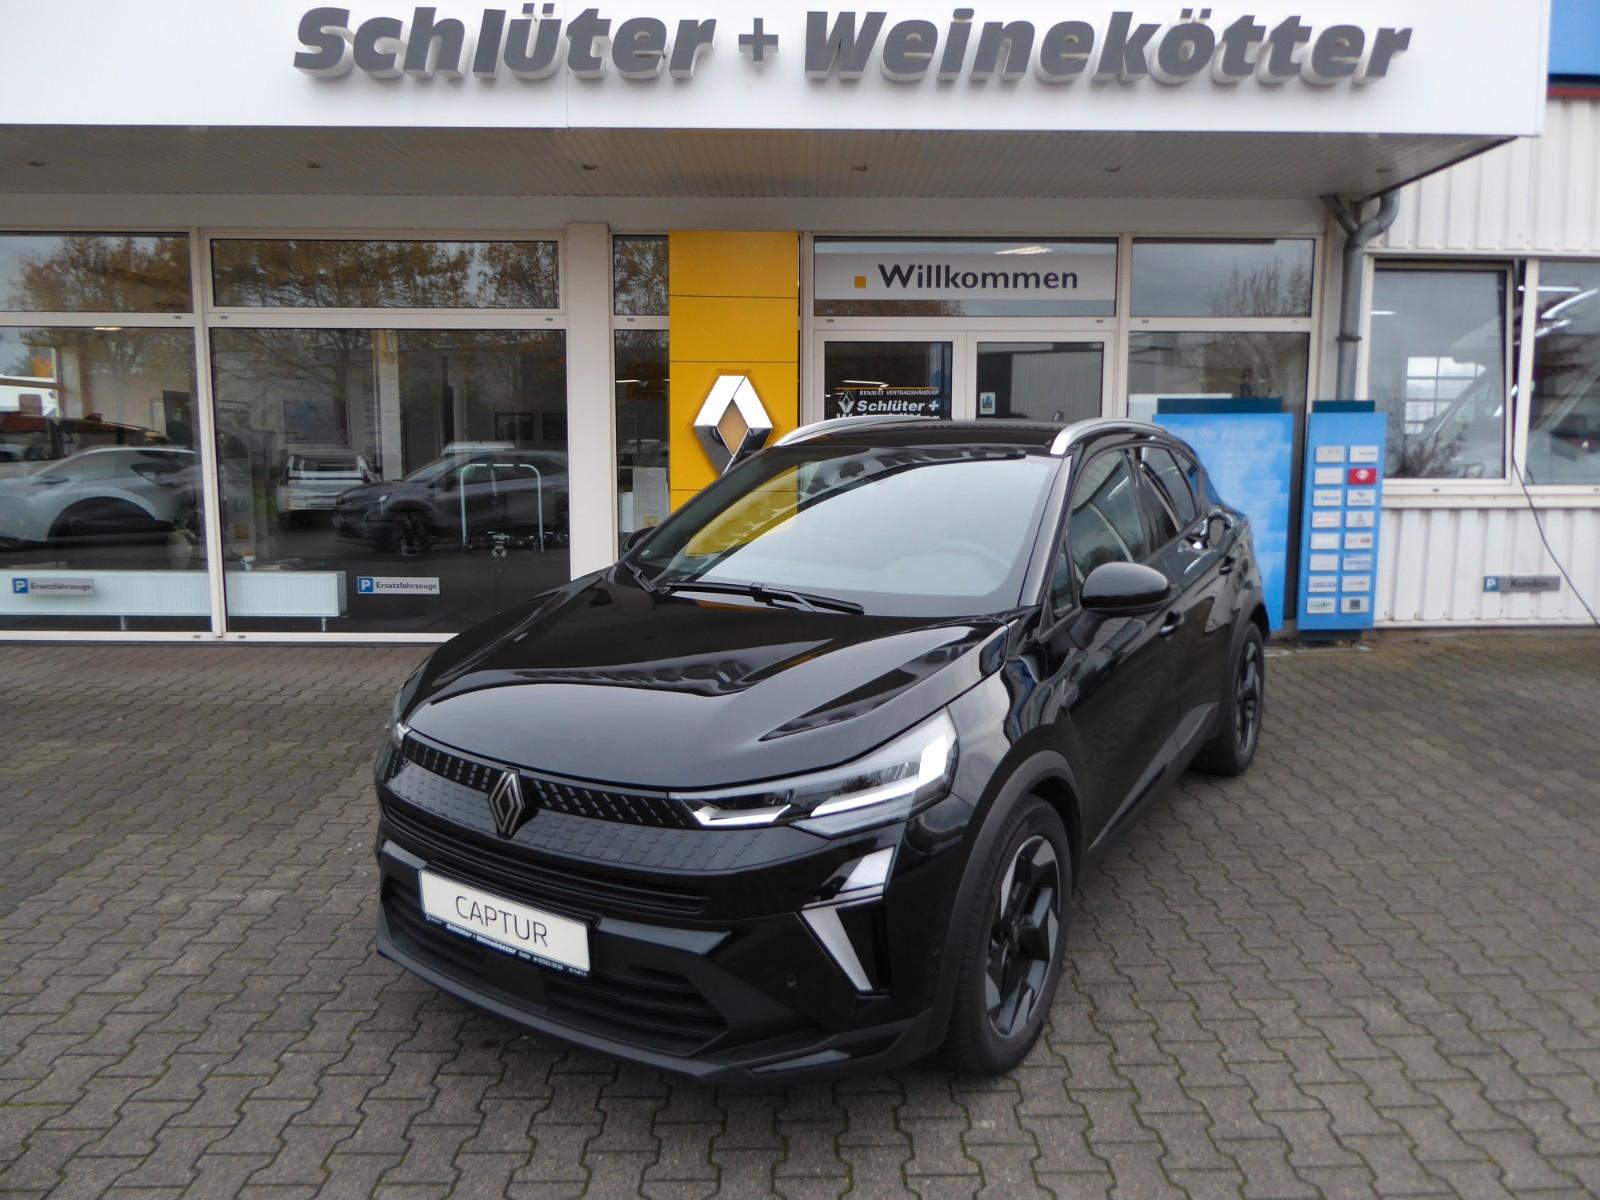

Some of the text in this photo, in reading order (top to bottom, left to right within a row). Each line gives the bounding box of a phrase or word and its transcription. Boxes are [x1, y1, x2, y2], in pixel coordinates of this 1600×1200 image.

[294, 3, 1413, 85] Schlüter + Weinekötter
[878, 264, 1078, 288] Willkommen
[856, 399, 940, 412] Schlüter +
[376, 582, 437, 590] Ersatzfahrzeuge
[455, 895, 548, 947] CAPTUR
